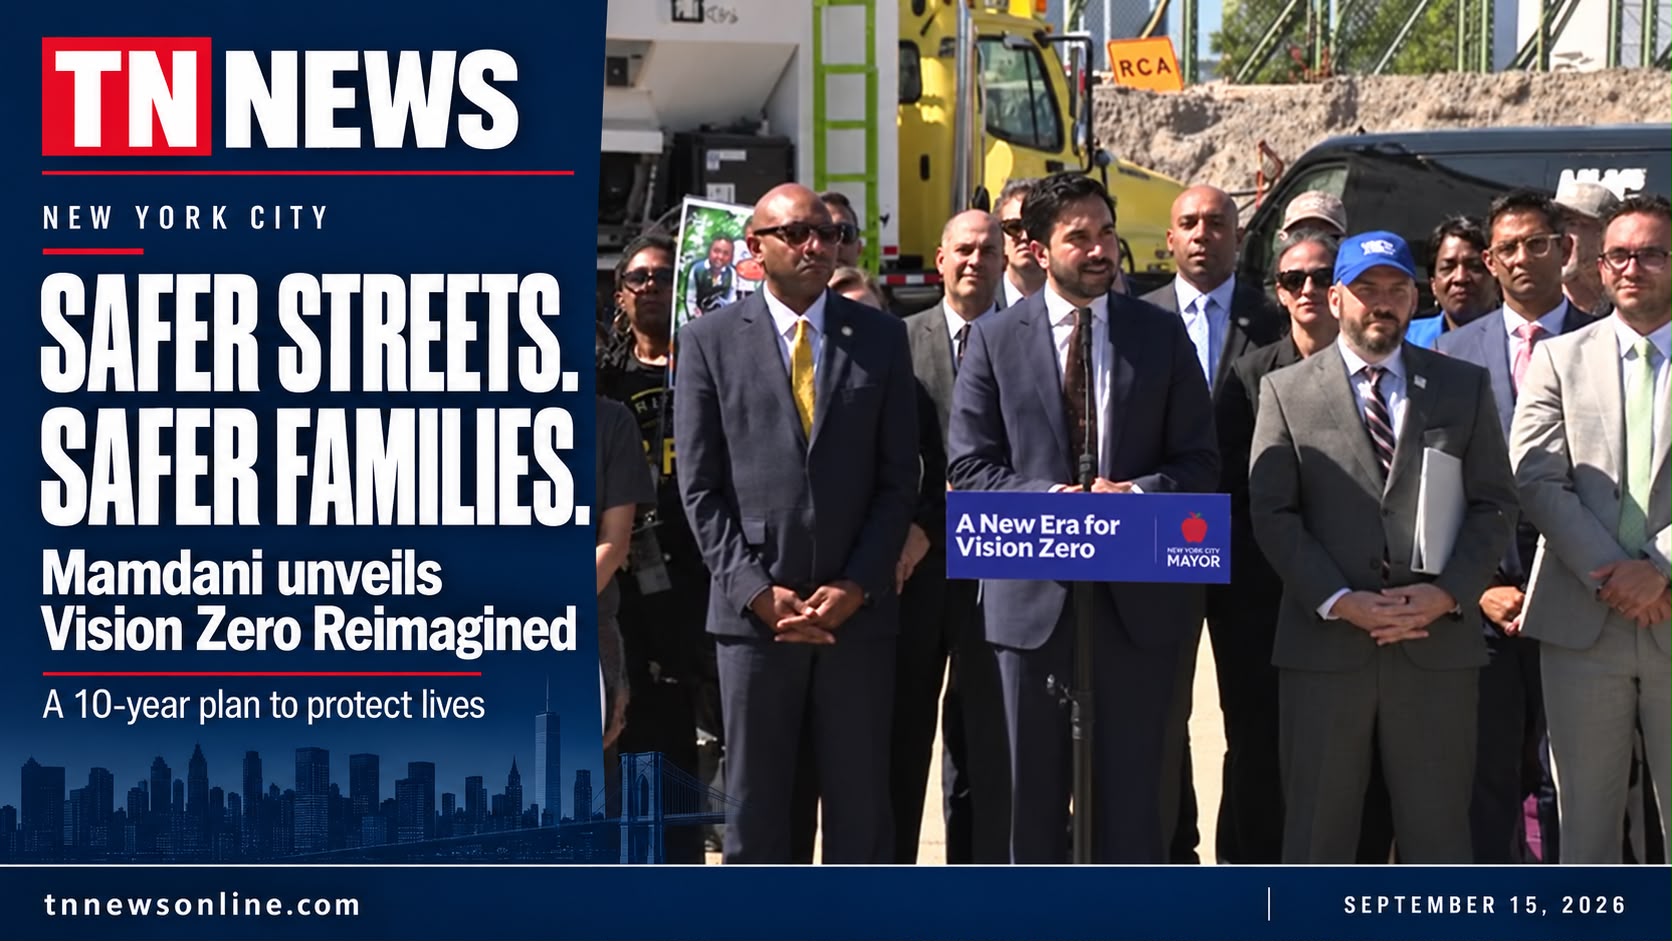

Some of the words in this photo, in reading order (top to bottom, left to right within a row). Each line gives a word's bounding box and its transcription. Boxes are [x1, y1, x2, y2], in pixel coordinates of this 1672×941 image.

[1119, 57, 1171, 77] RCA
[955, 513, 976, 534] A
[980, 514, 1036, 534] New
[1040, 514, 1080, 535] Era
[1083, 514, 1121, 536] for
[955, 536, 1034, 558] Vision
[1038, 538, 1096, 559] Zero
[1167, 554, 1221, 568] MAYOR
